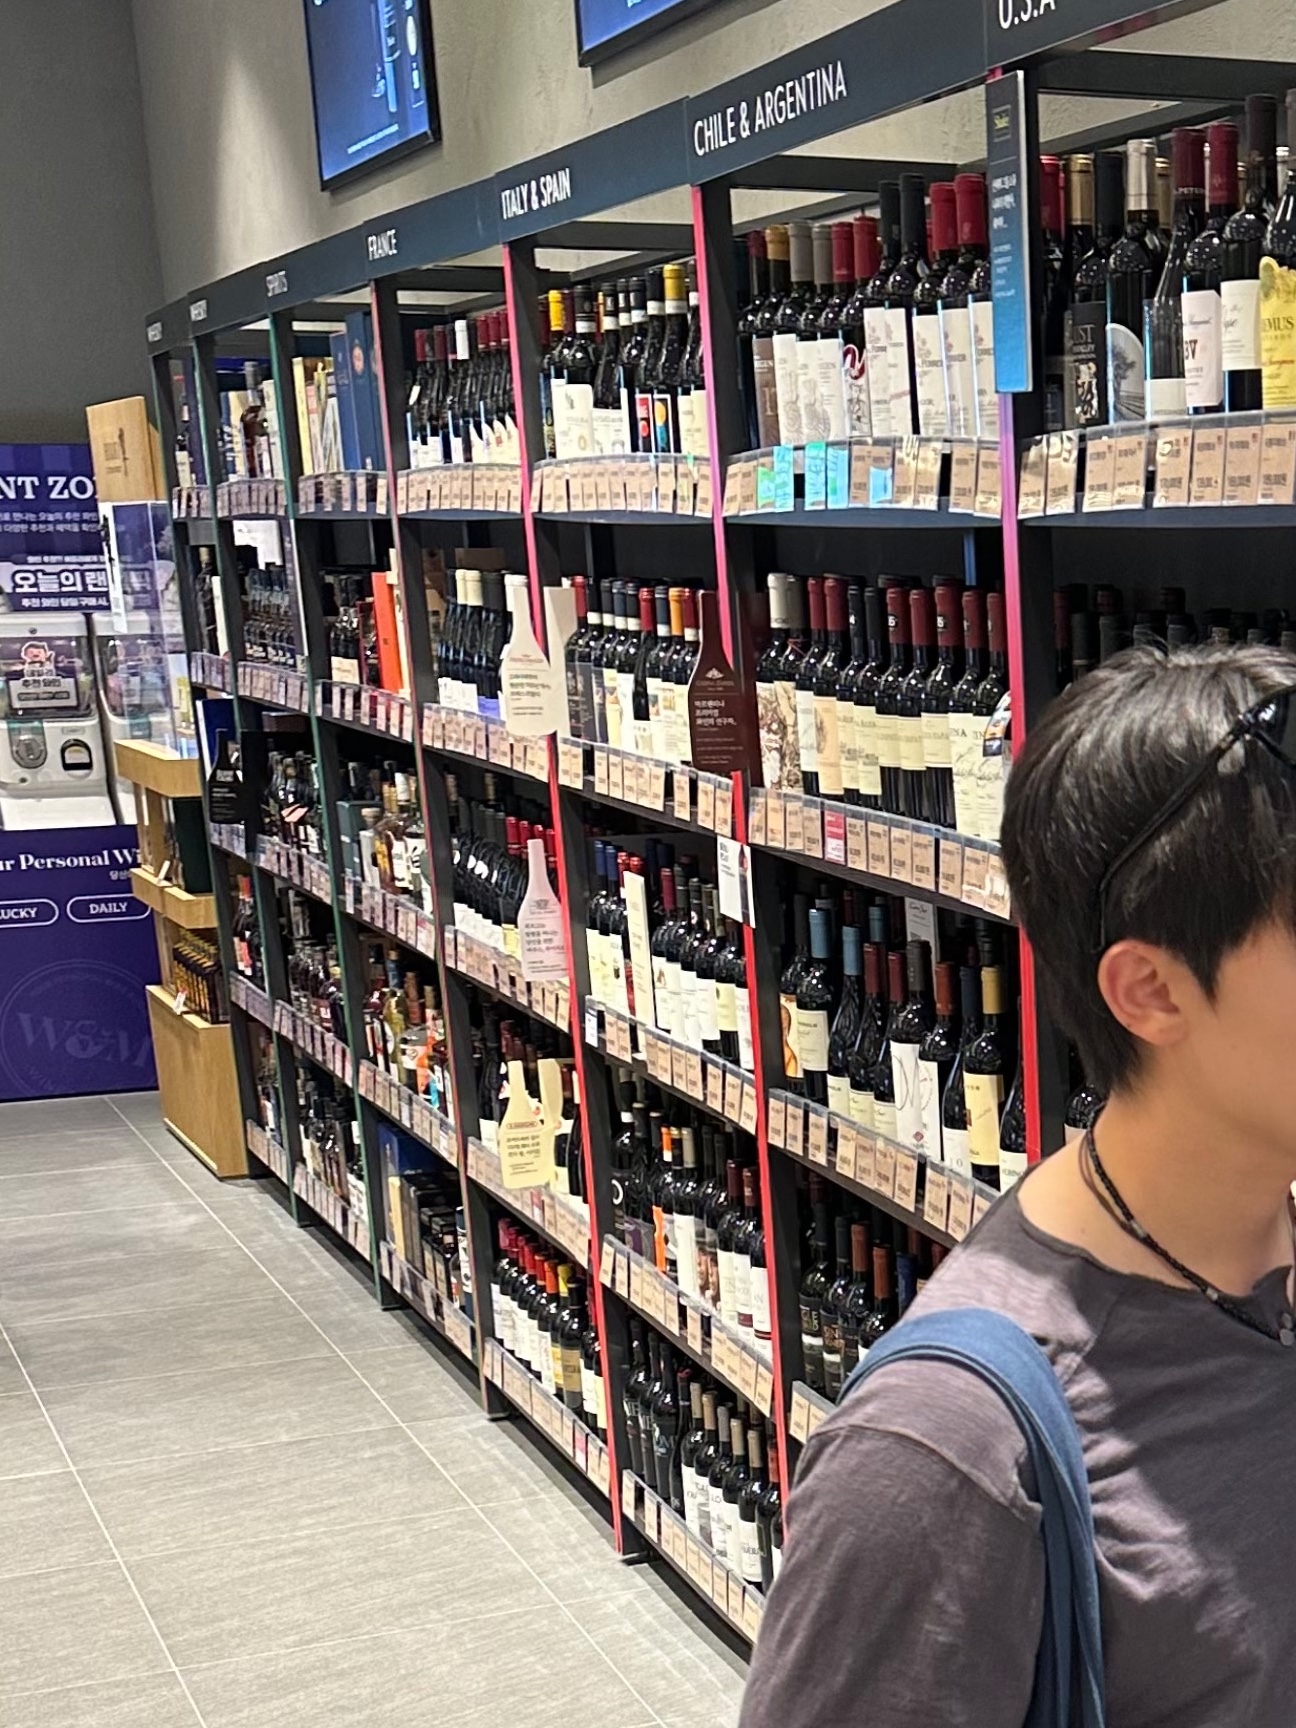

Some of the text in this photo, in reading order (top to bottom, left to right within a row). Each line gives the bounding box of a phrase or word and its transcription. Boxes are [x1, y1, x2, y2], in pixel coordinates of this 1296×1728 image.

[694, 60, 847, 157] CHILE & ARGENTINA
[501, 167, 571, 220] ITALY & SPAIN
[367, 229, 398, 260] FRANCE
[48, 476, 98, 499] ZO
[14, 571, 83, 593] 오늘의
[20, 852, 109, 871] Personal
[89, 902, 127, 915] DAILY
